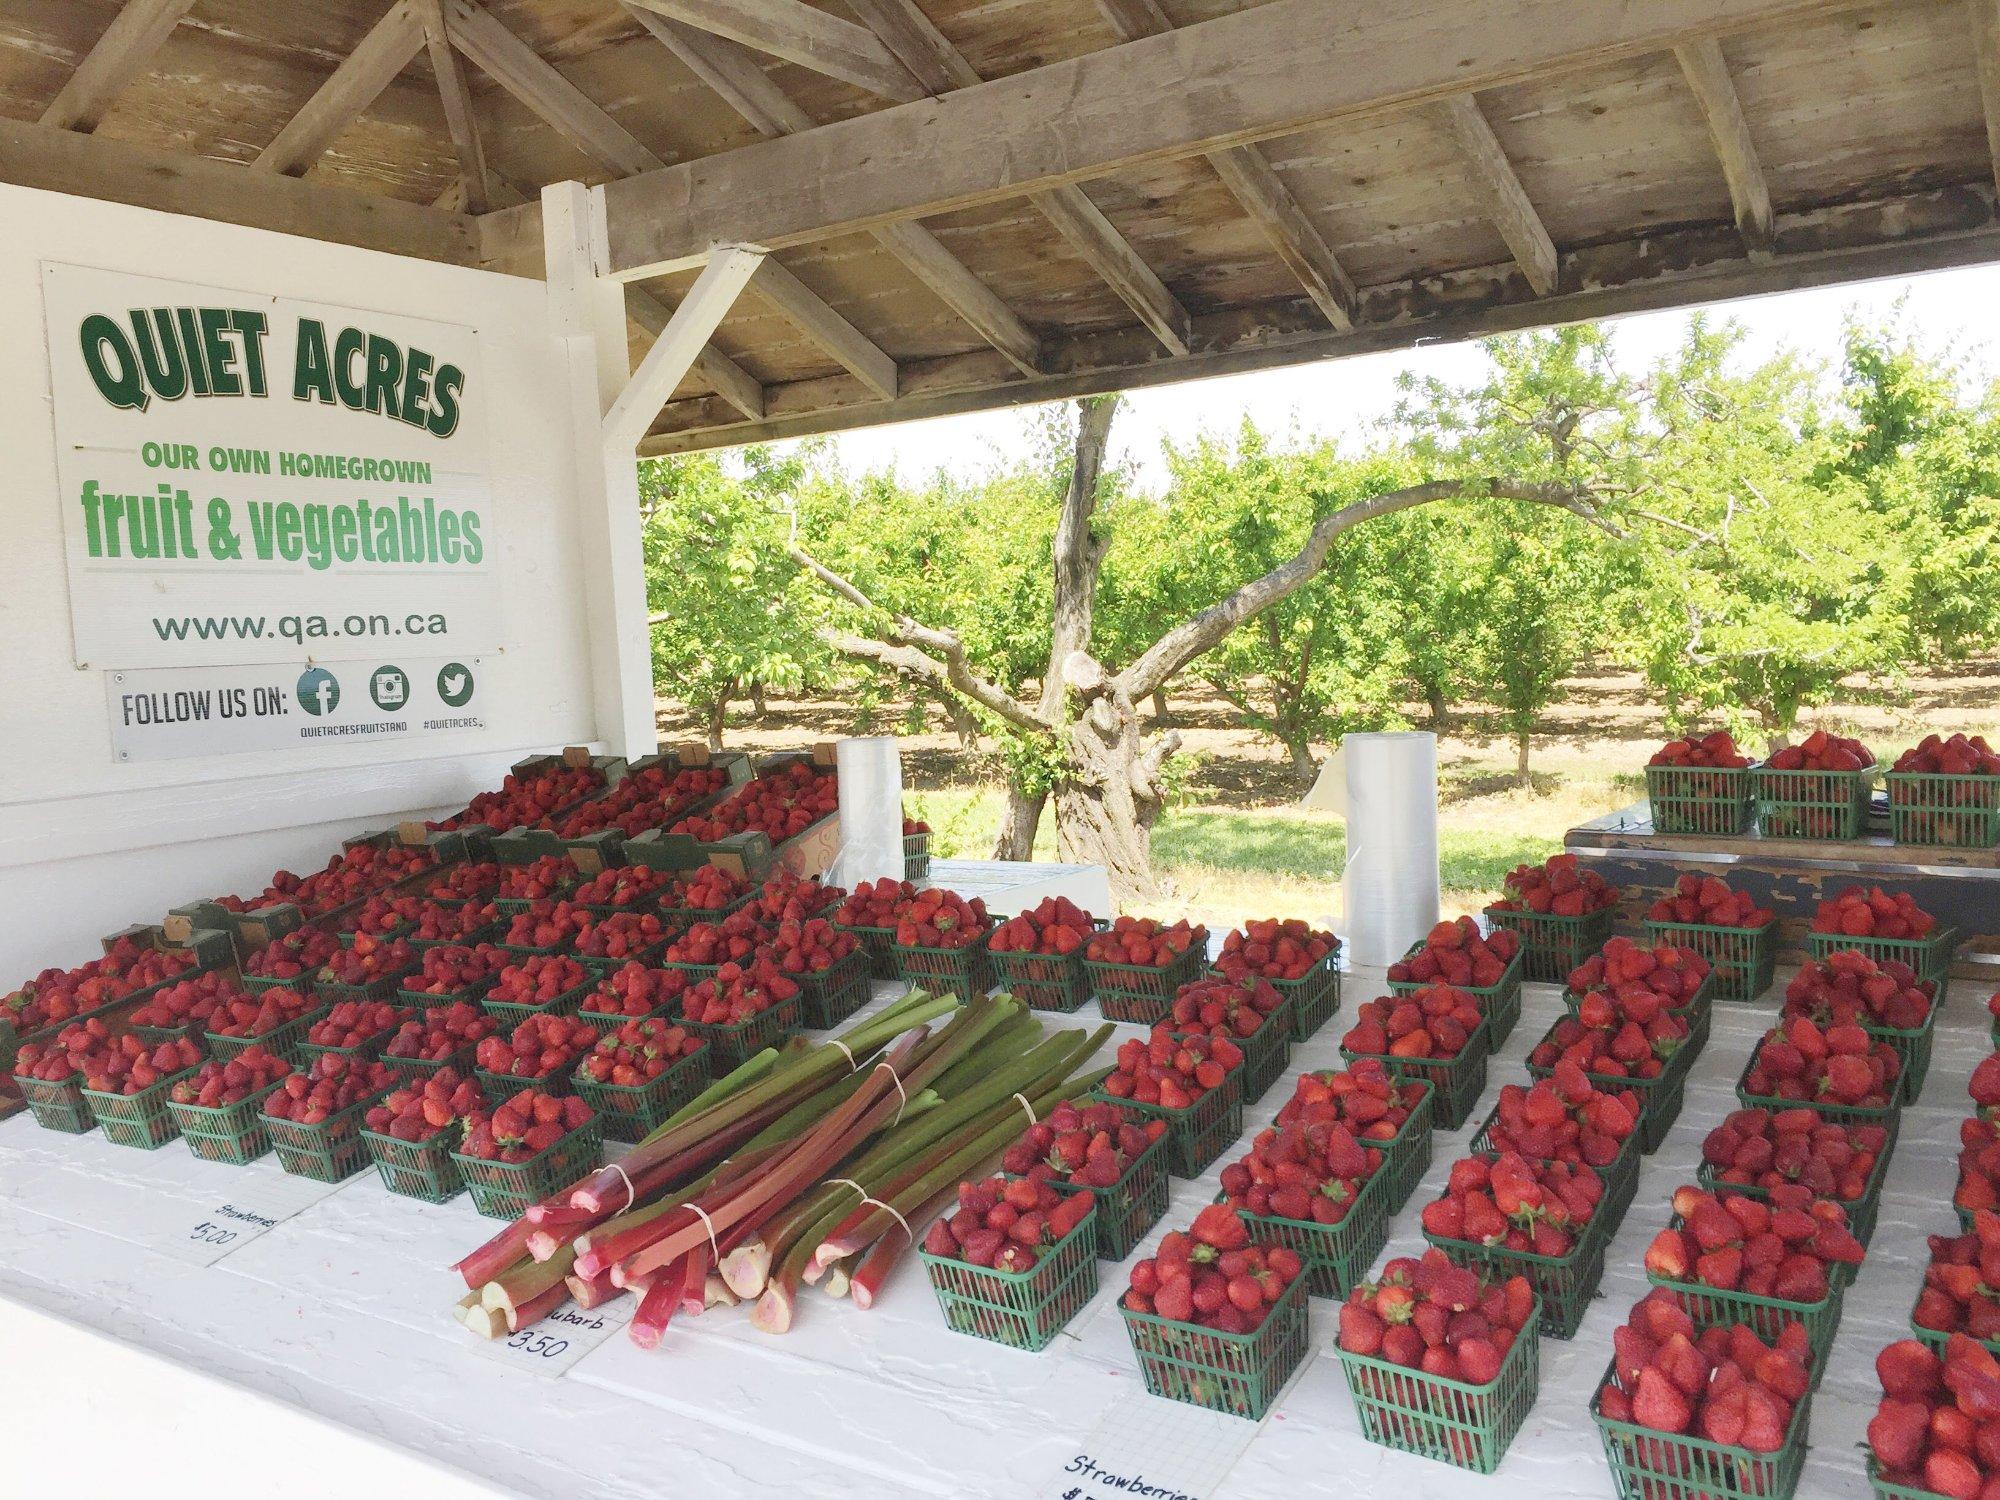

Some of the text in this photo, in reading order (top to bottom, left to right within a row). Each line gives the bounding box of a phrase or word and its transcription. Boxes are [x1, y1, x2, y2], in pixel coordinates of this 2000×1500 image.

[79, 306, 464, 438] QUIET ACRES
[142, 441, 432, 484] OUR OWN HOMEGROWN
[81, 480, 483, 571] fruit & vegetables
[152, 612, 448, 644] www.qa.on.ca
[121, 686, 288, 726] FOLLOW US ON:
[300, 722, 407, 738] QUIETACRESFRUITSTAND
